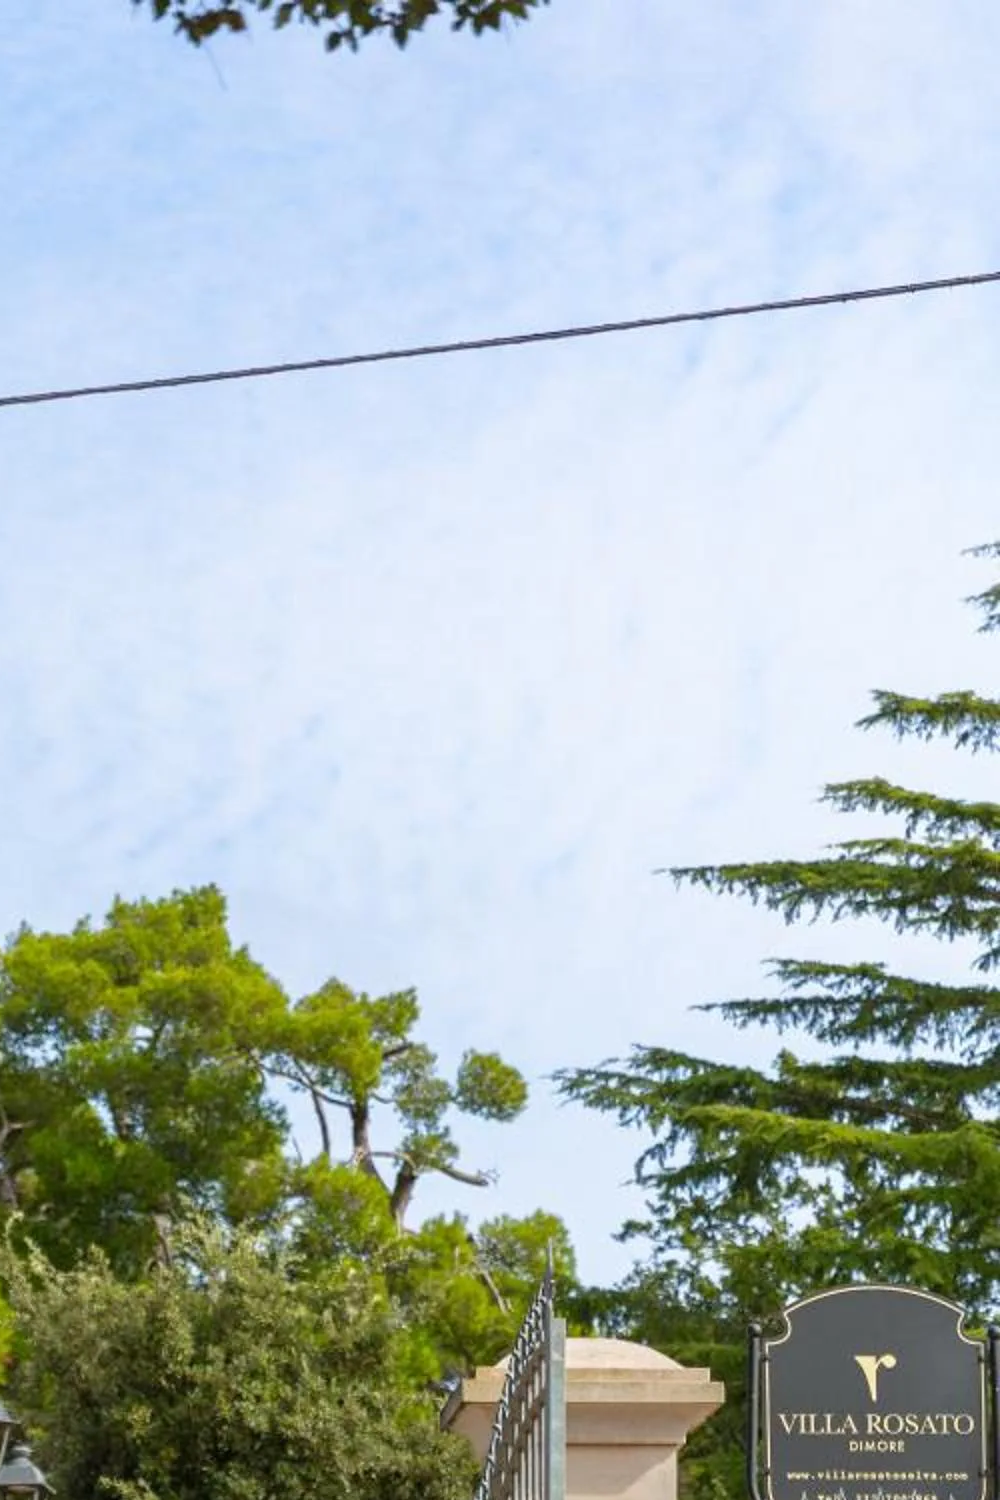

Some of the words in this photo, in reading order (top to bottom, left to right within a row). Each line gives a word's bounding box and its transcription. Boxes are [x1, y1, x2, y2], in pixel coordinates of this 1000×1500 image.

[778, 1413, 859, 1435] VILLA
[866, 1413, 975, 1435] ROSATO
[849, 1440, 904, 1452] DIMORE
